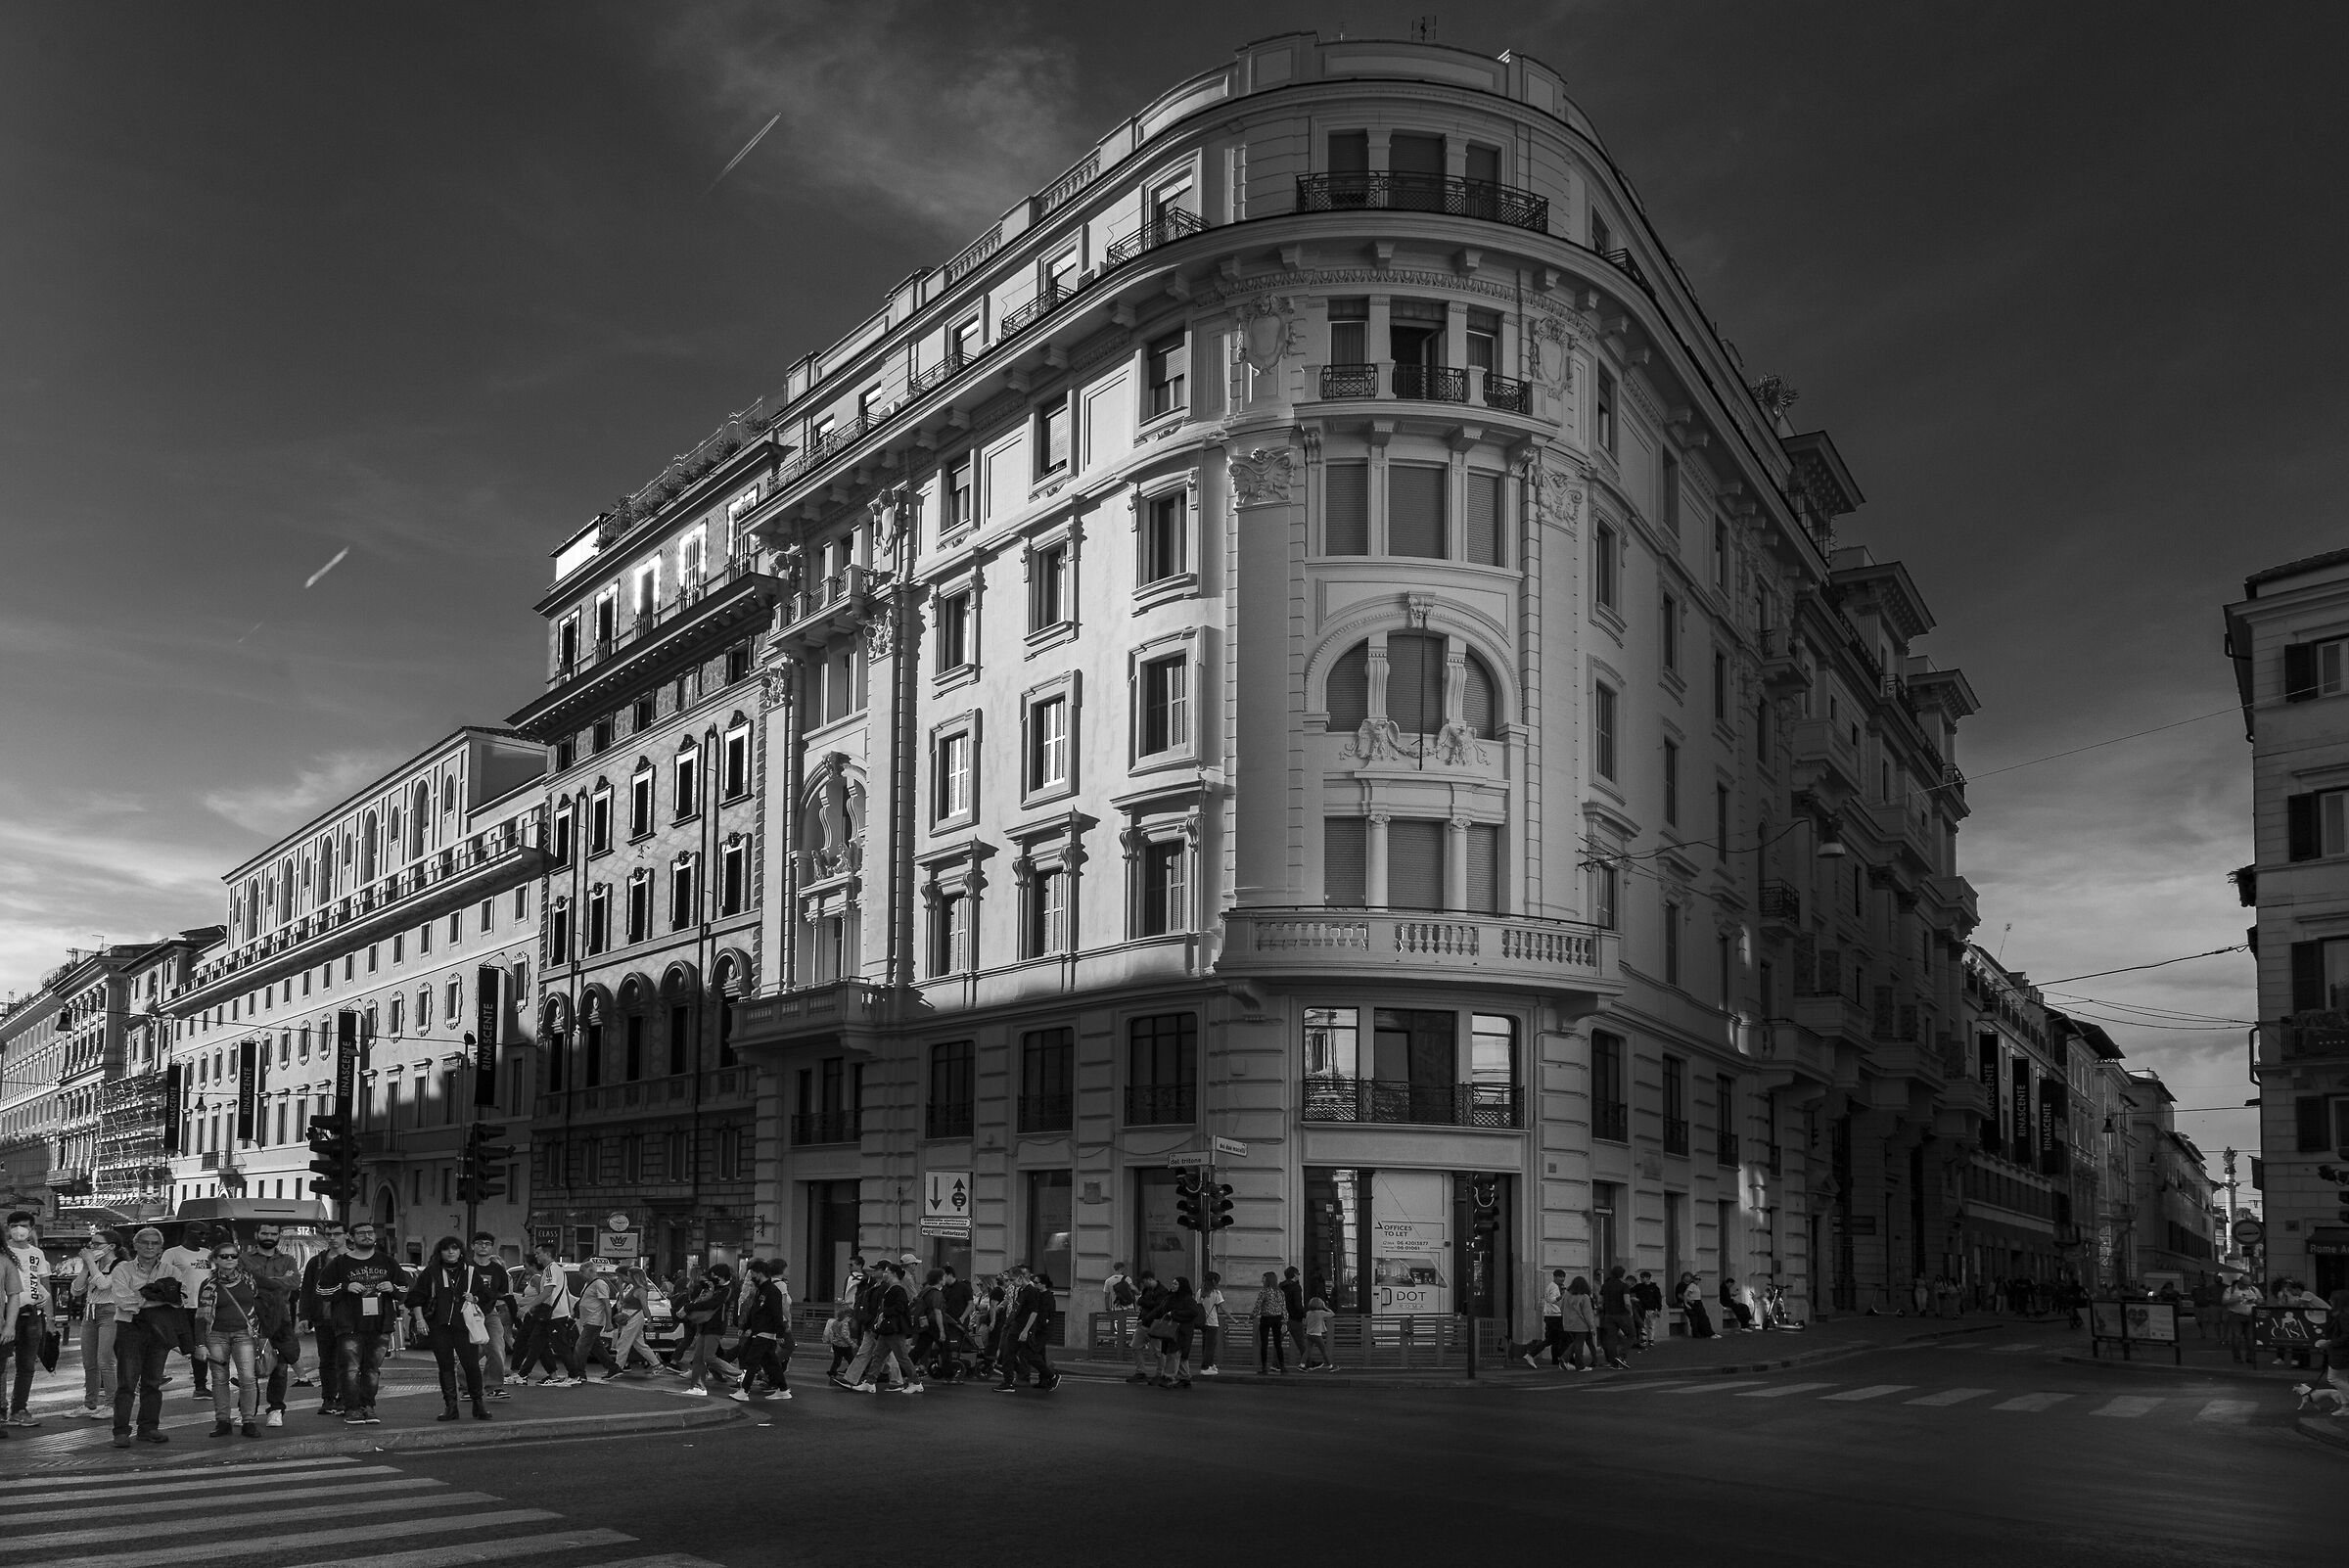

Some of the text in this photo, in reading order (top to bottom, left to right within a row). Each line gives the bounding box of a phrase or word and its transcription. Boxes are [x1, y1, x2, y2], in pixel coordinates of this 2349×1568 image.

[481, 1002, 493, 1072] RINASCENTE
[168, 1085, 177, 1129] RINASCENTE
[242, 1066, 253, 1115] RINASCENTE
[2016, 1084, 2027, 1137] RINASCENTE
[2042, 1102, 2052, 1151] RINASCENTE
[2310, 1244, 2337, 1254] Rome
[1397, 1290, 1426, 1302] DOT
